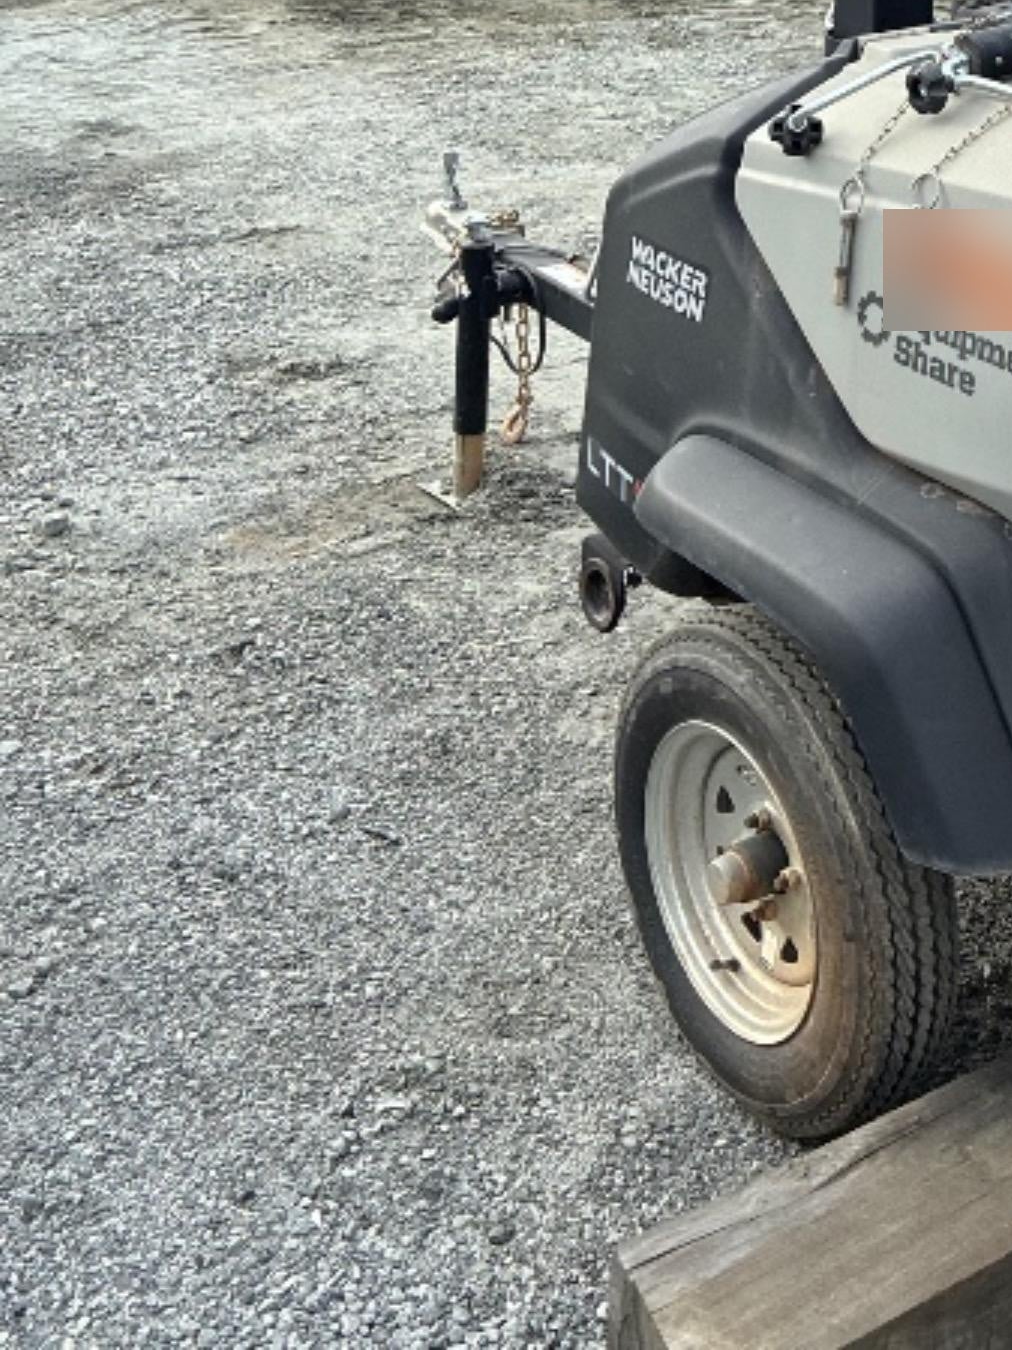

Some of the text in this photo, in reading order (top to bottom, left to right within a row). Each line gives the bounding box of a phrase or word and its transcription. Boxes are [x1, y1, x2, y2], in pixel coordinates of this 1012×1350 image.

[626, 259, 705, 323] NEUSON
[631, 235, 708, 299] WACKER
[893, 334, 976, 397] Share
